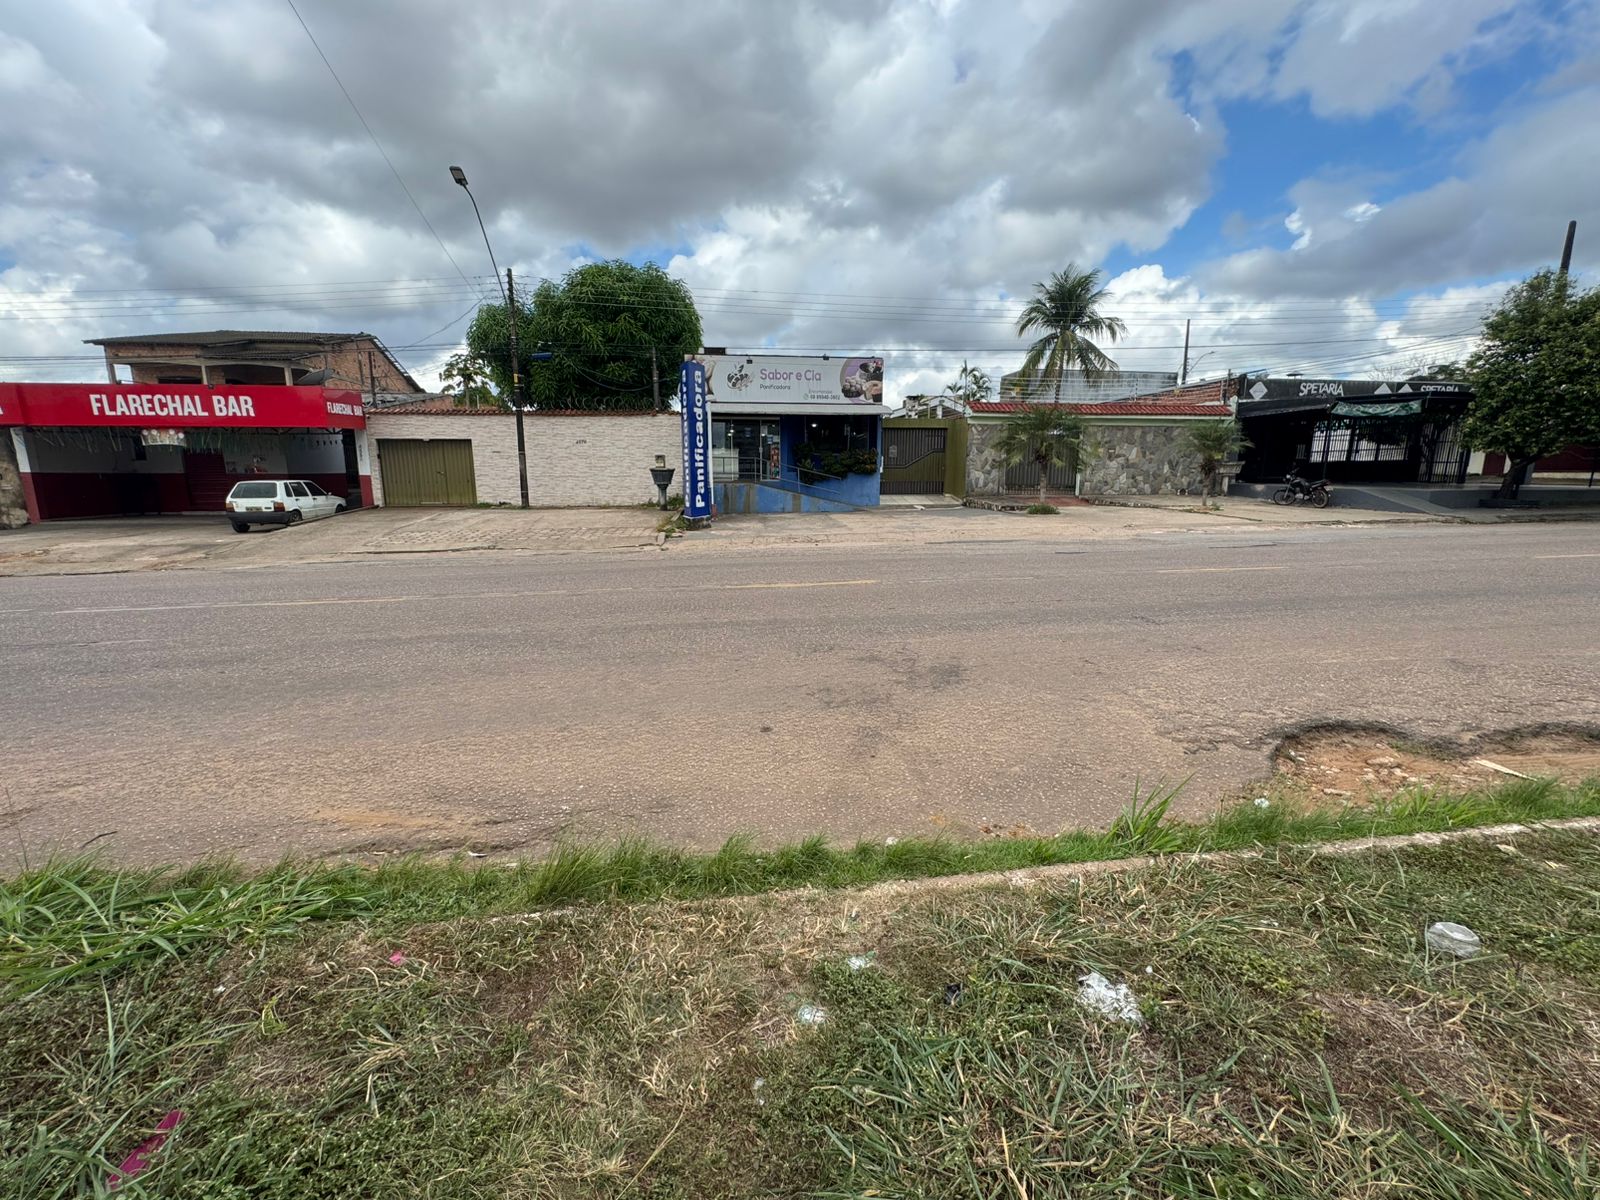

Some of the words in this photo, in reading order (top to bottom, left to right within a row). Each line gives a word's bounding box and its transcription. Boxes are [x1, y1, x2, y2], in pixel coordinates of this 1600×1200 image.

[760, 368, 793, 381] Sabor
[795, 372, 803, 381] e
[804, 369, 822, 381] Cia
[89, 393, 209, 417] FLARECHAL
[212, 394, 255, 417] BAR
[694, 370, 705, 508] Panificadora
